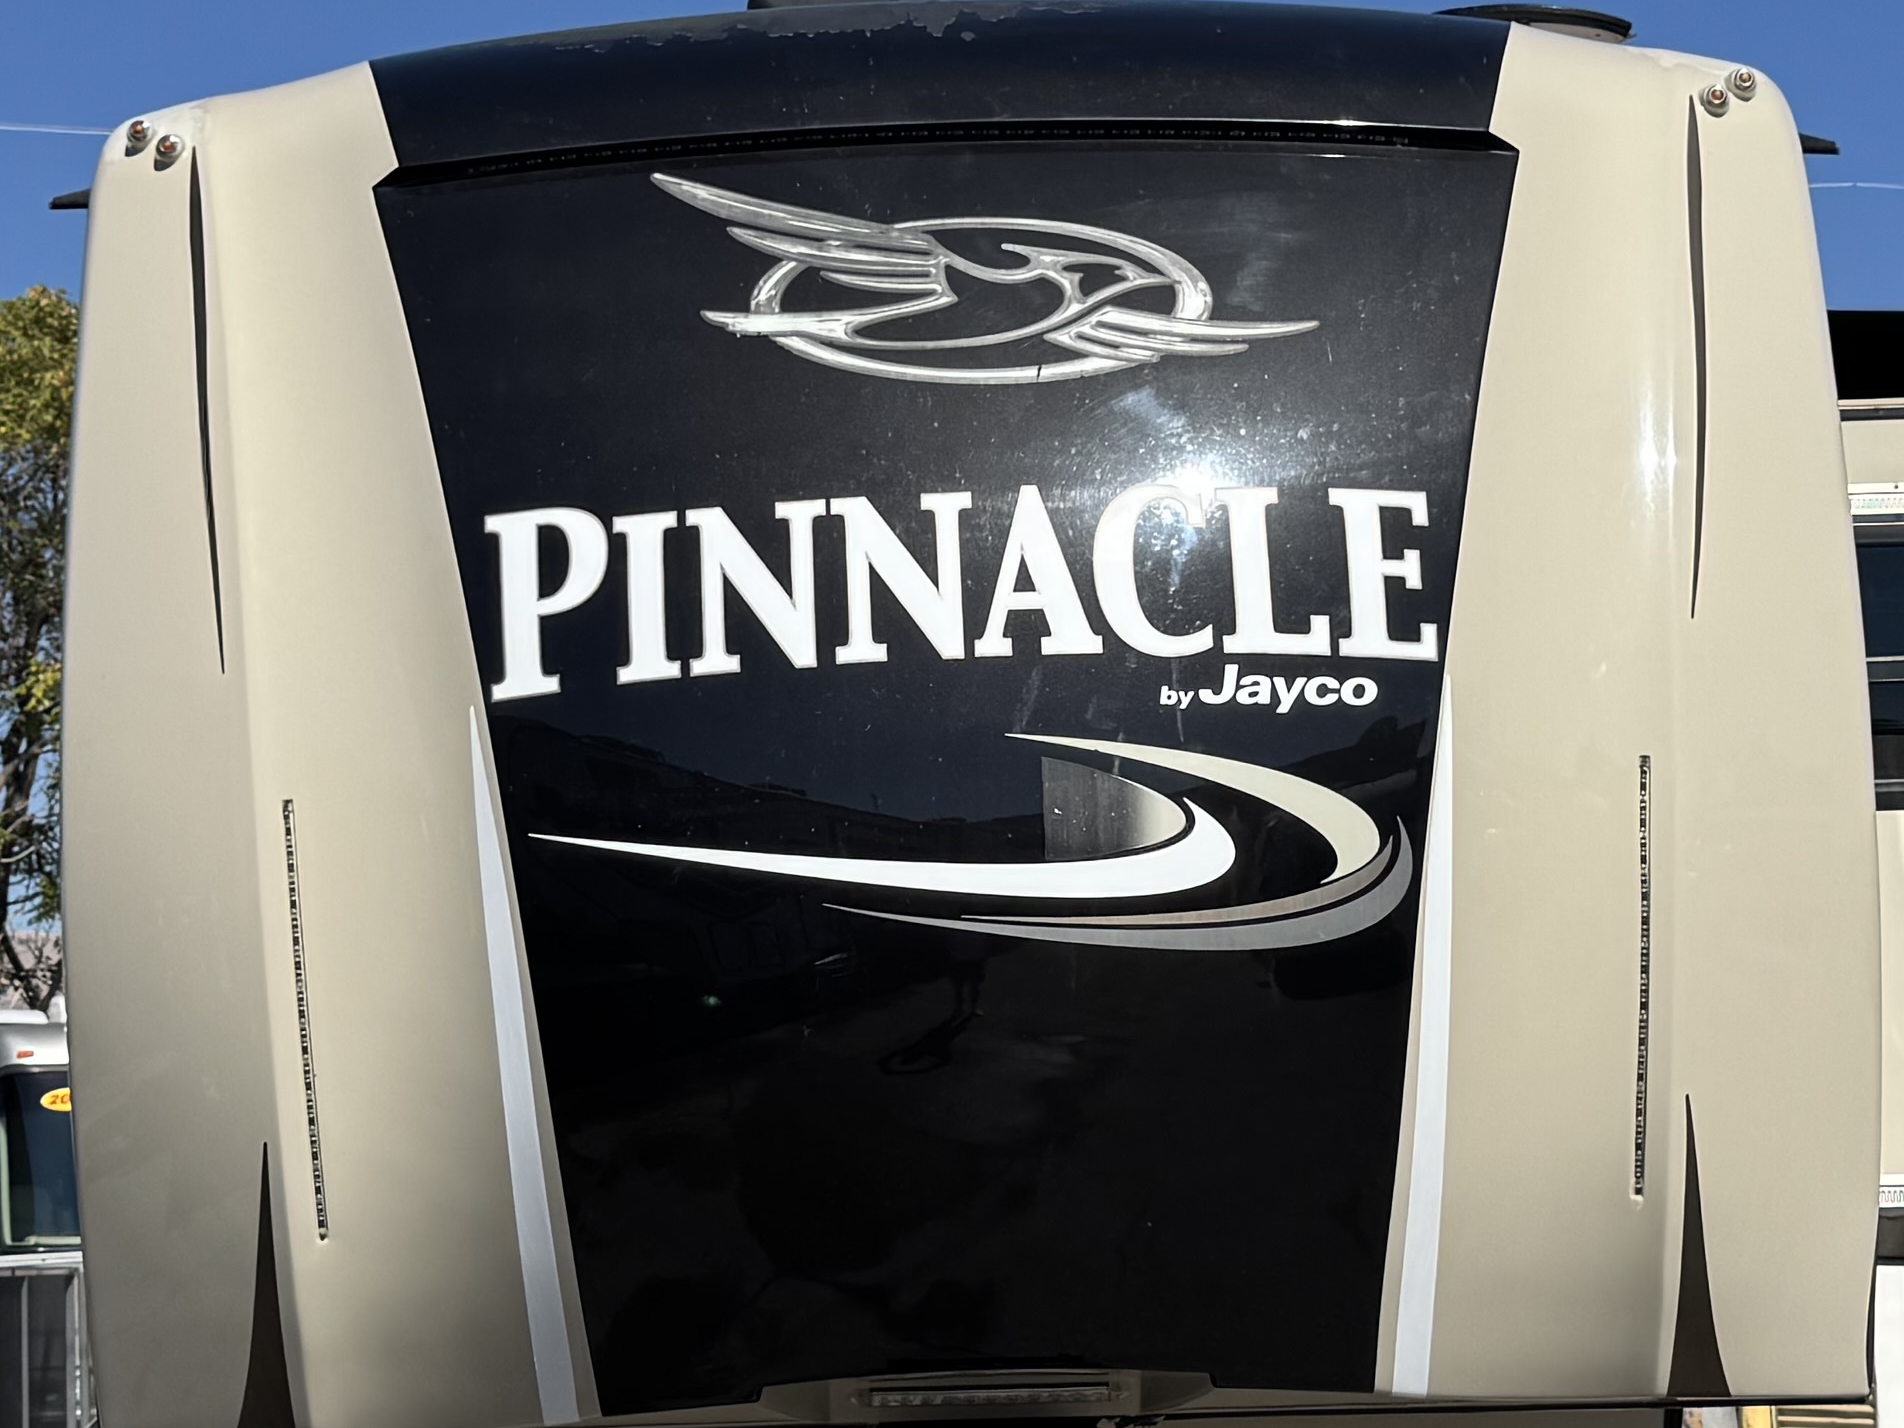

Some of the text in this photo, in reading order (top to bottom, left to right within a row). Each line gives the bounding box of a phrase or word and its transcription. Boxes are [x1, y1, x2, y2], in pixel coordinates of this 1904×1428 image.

[483, 484, 1439, 703] PINNACLE
[1159, 663, 1379, 714] by Jayco
